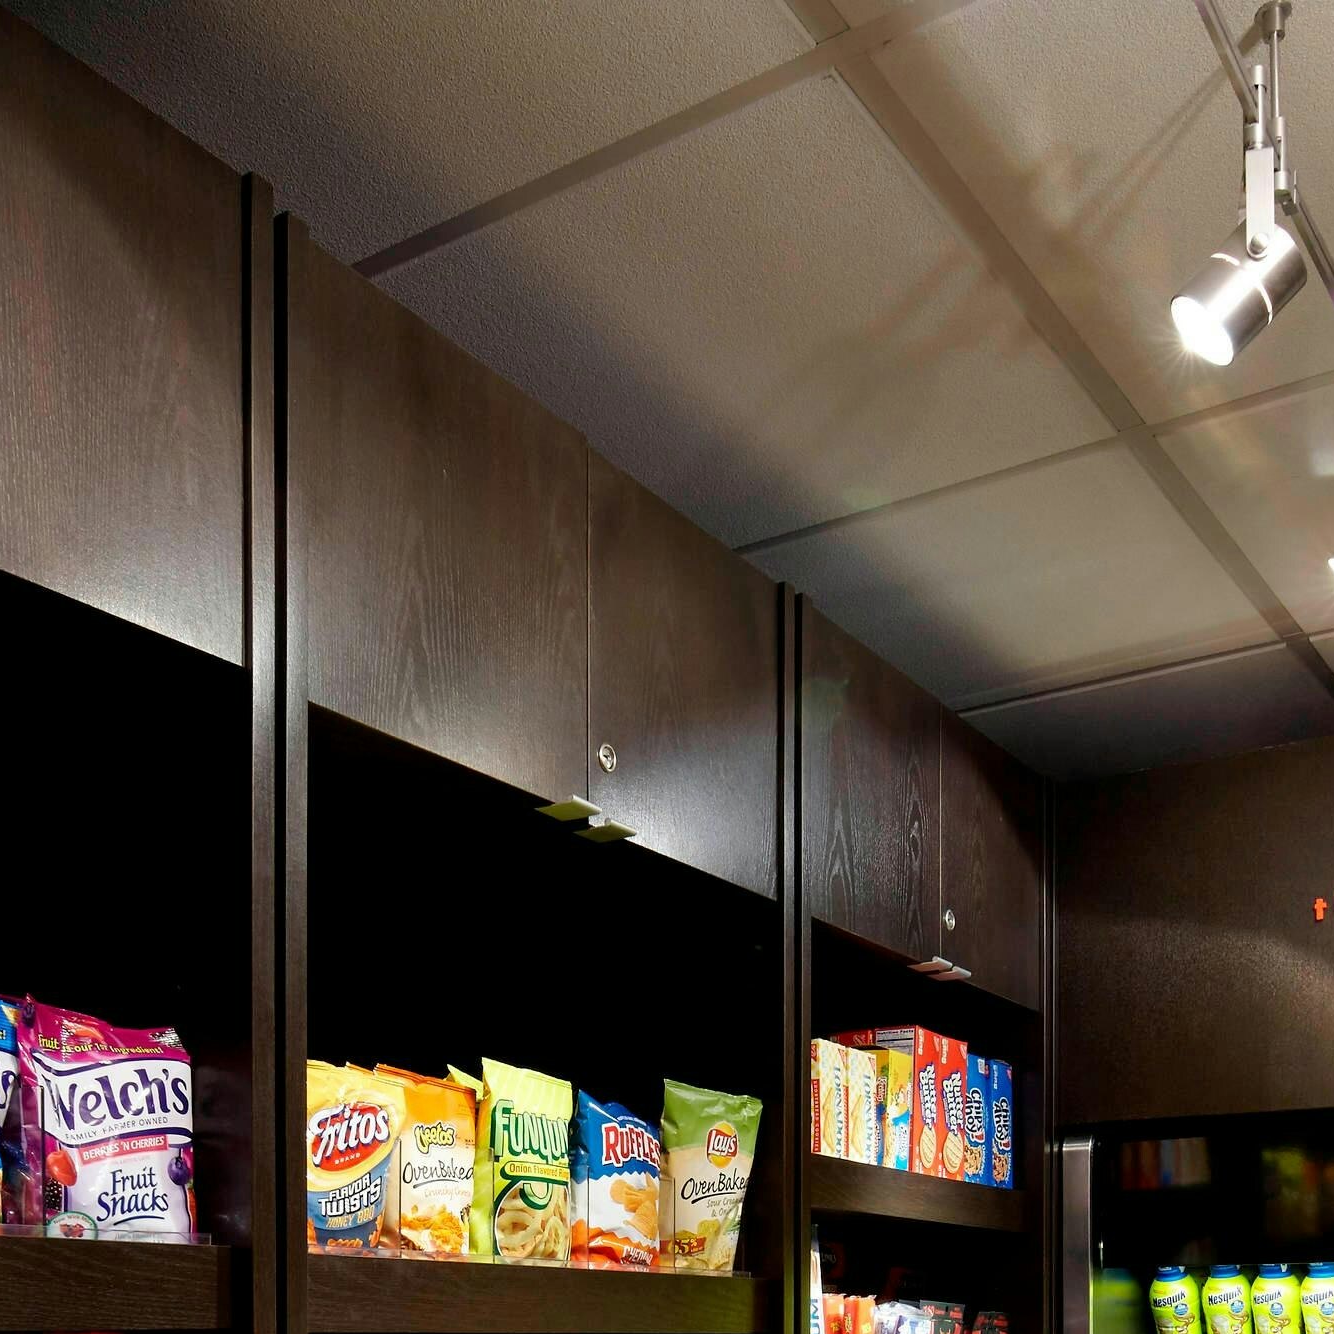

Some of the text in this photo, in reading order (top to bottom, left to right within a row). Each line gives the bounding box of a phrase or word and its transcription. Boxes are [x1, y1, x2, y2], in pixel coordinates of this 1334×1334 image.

[40, 1068, 191, 1132] Welch's
[130, 1135, 166, 1150] CHERRIES
[308, 1103, 391, 1168] Fritos
[601, 1123, 662, 1167] RUFFLES
[707, 1128, 738, 1158] Lay's
[109, 1166, 159, 1196] Fruit
[329, 1172, 373, 1201] FLAVOR
[96, 1186, 170, 1222] Snacks
[317, 1175, 384, 1218] TWISTS
[325, 1205, 376, 1229] HONEY BBQ
[1153, 1289, 1187, 1308] Nesquik
[1208, 1285, 1244, 1307] Nesquik
[1252, 1288, 1283, 1306] Nesquik
[1301, 1288, 1334, 1306] Nesquik
